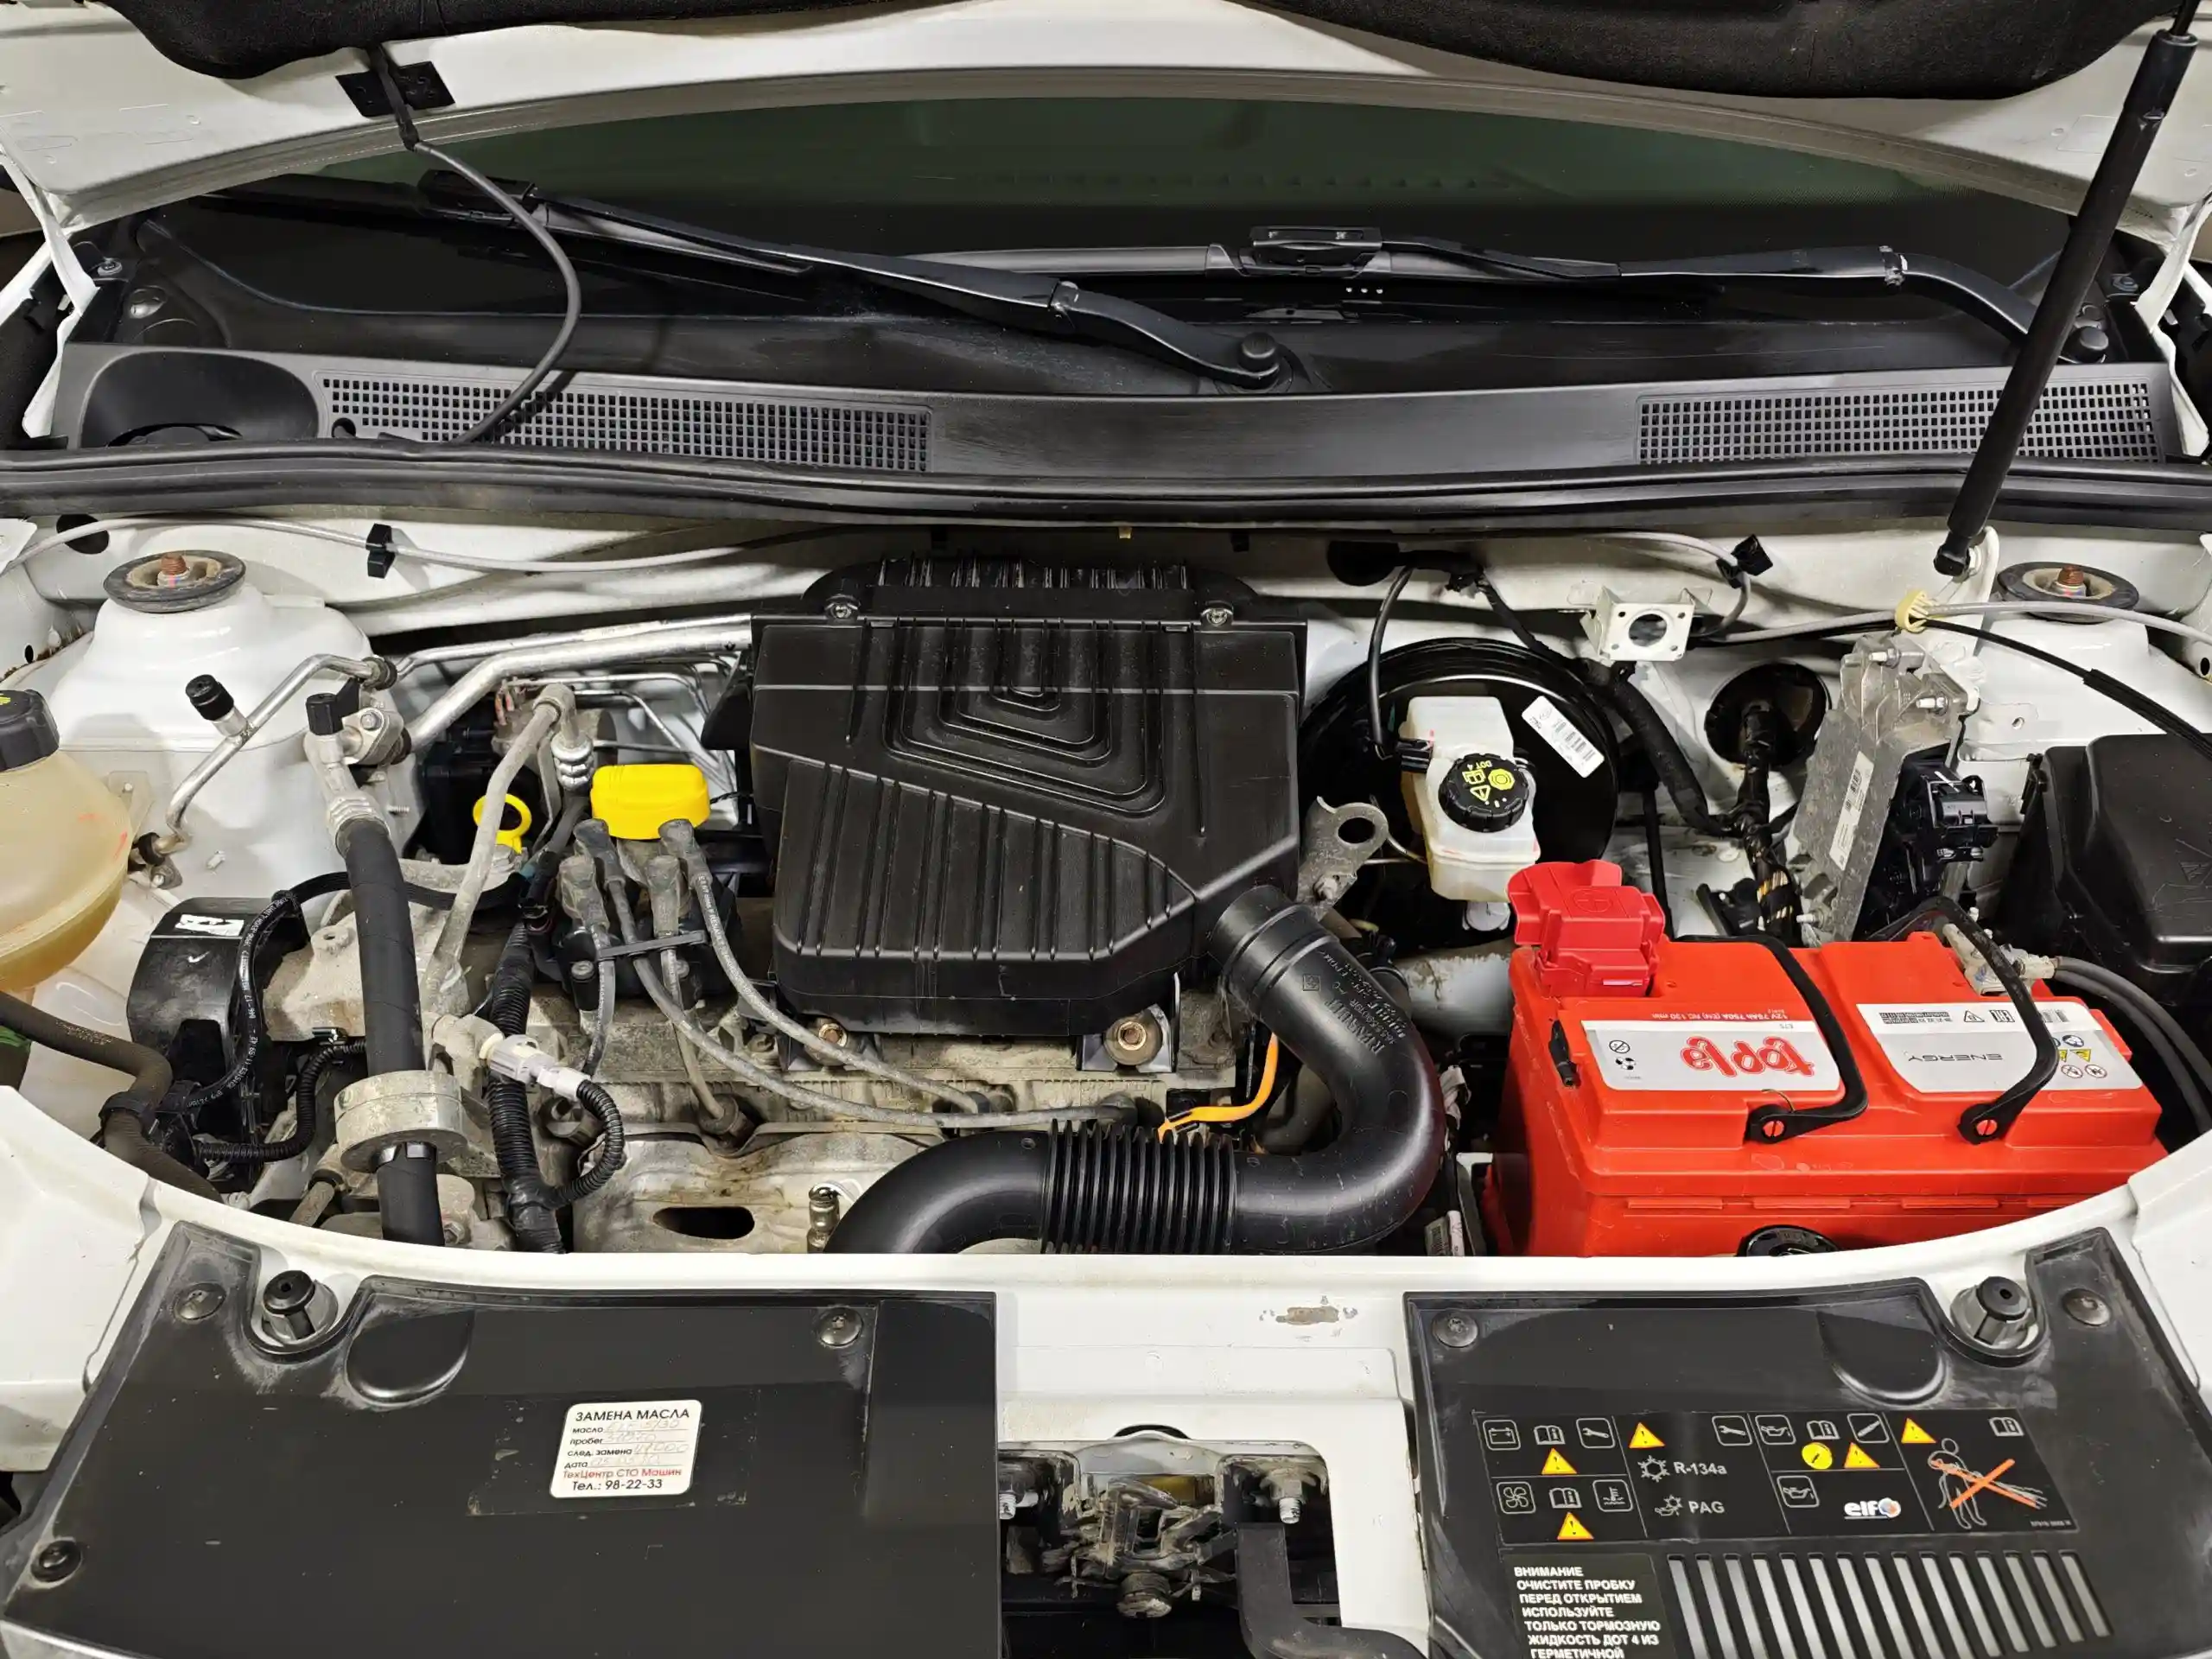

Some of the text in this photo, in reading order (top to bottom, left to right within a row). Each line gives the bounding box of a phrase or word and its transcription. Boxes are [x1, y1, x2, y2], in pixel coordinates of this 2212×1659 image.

[1476, 760, 1493, 769] DOT
[1325, 998, 1387, 1055] RENAULT
[1681, 1036, 1815, 1077] topla
[1907, 1052, 2003, 1062] ENERGY
[575, 1408, 690, 1422] ЗАМЕНА МАСЛА
[569, 1437, 603, 1446] пробег
[563, 1469, 613, 1479] ТехЦентр
[641, 1468, 682, 1477] Машин
[1673, 1461, 1727, 1476] R-134a
[605, 1479, 663, 1490] 98-22-33
[1689, 1501, 1725, 1514] PAG
[1844, 1499, 1879, 1516] elf
[1514, 1567, 1584, 1577] ВНИМАНИЕ
[1516, 1580, 1636, 1591] ОЧИСТИТЕ ПРОБКУ
[1519, 1593, 1643, 1605] ПЕРЕД ОТКРЫТИЕМ
[1522, 1605, 1615, 1618] ИСПОЛЬЗУЙТЕ
[1524, 1621, 1661, 1631] ТОЛЬКО ТОРМОЗНУЮ
[1528, 1634, 1660, 1647] ЖИДКОСТЬ ДОТ 4 ИЗ
[1530, 1646, 1624, 1659] ГЕРМЕТИЧНОЙ
